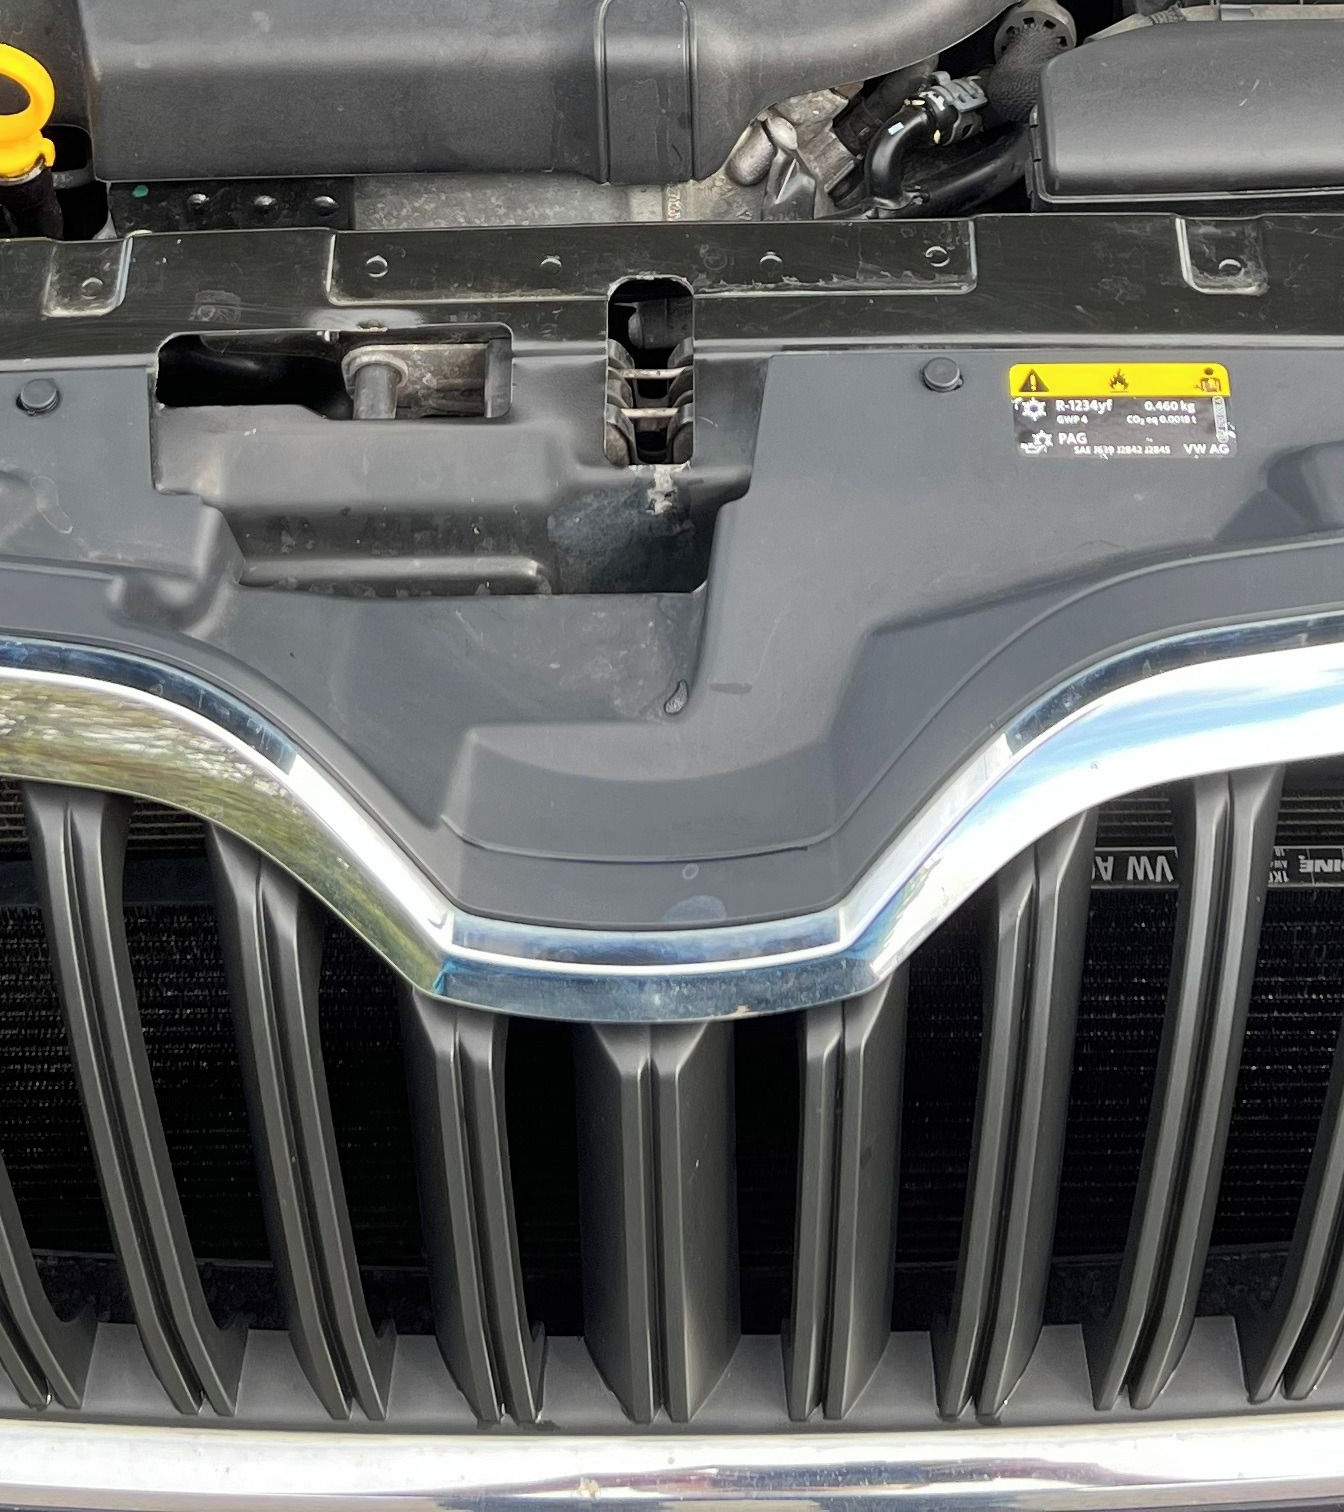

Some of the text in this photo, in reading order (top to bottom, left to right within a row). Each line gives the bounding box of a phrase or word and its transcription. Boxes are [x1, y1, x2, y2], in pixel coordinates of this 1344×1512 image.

[1055, 399, 1196, 415] R-1234yf 0.460 kg
[1056, 414, 1080, 425] GWP
[1081, 415, 1089, 424] 4
[1146, 416, 1159, 426] eq
[1058, 432, 1088, 445] PAG
[1074, 445, 1092, 455] SAE
[1184, 443, 1207, 455] VW
[1209, 443, 1230, 455] AG
